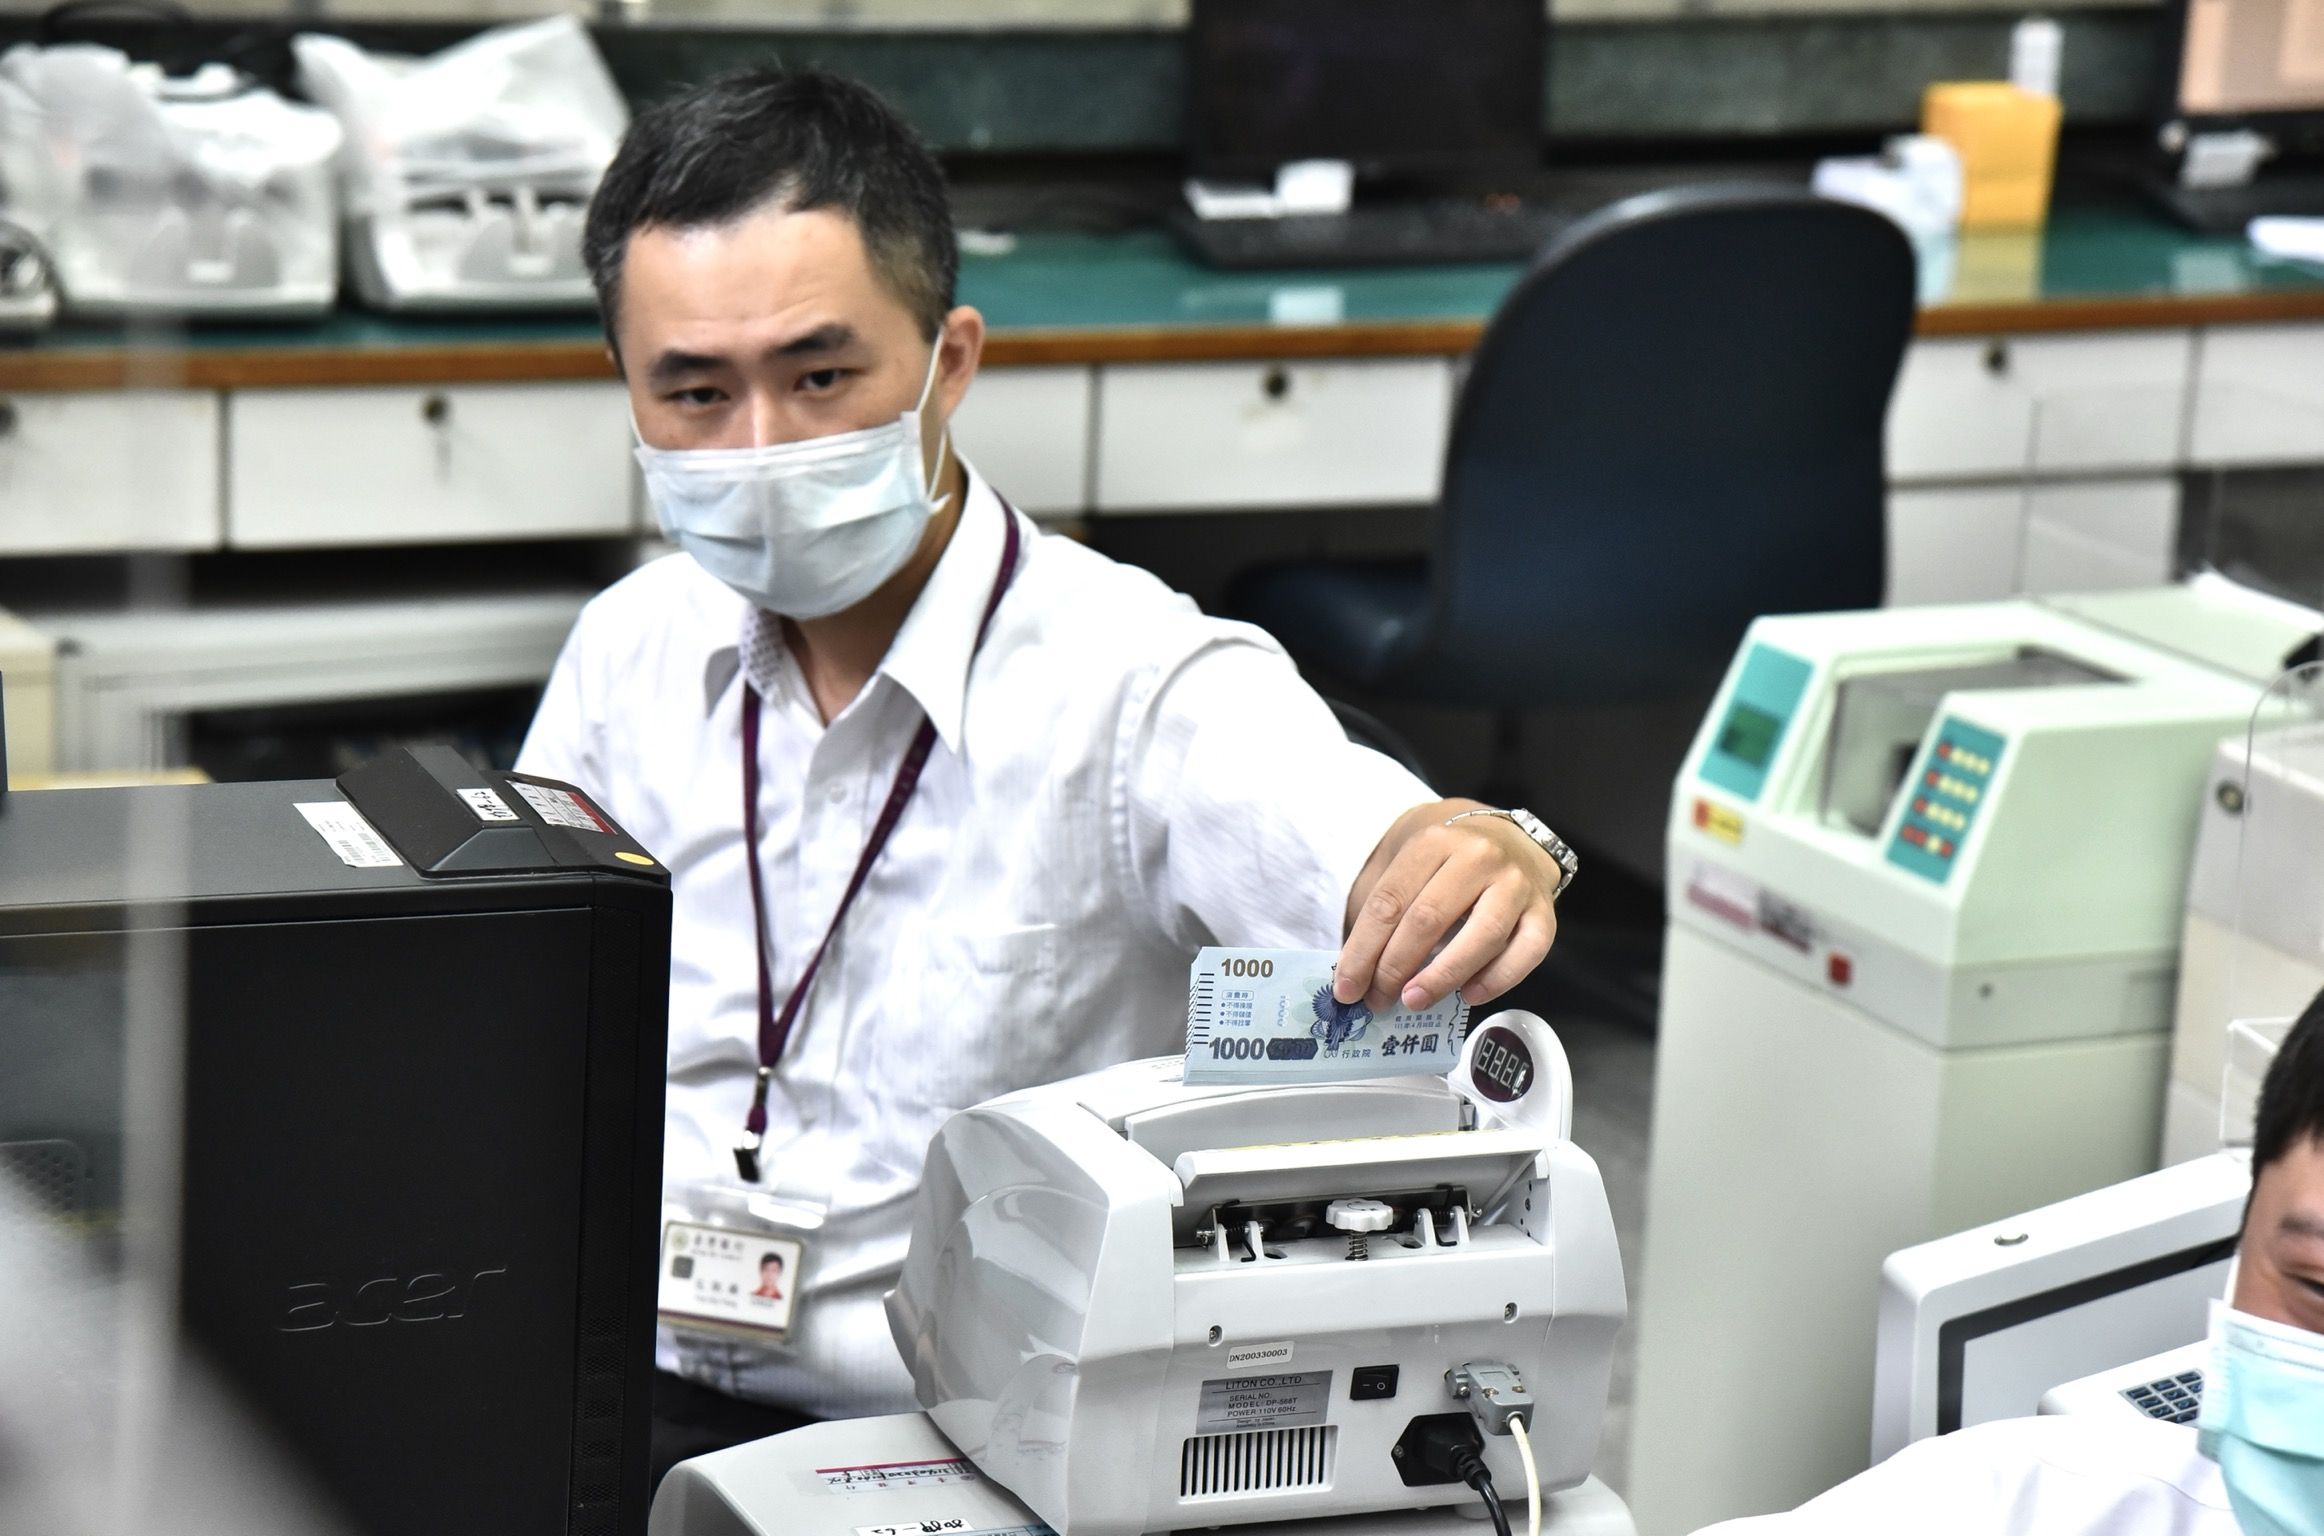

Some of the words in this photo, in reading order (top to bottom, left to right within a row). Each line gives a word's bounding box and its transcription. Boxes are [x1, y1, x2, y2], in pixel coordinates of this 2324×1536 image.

[1221, 958, 1274, 978] 1000
[1209, 1037, 1266, 1060] 1000
[1381, 1033, 1440, 1057] 壹仟圓
[1341, 1049, 1372, 1059] 行政院
[272, 1267, 508, 1332] acer
[1229, 1348, 1288, 1362] DN200330003
[1225, 1379, 1257, 1390] LITON
[1229, 1393, 1257, 1402] SERIAL
